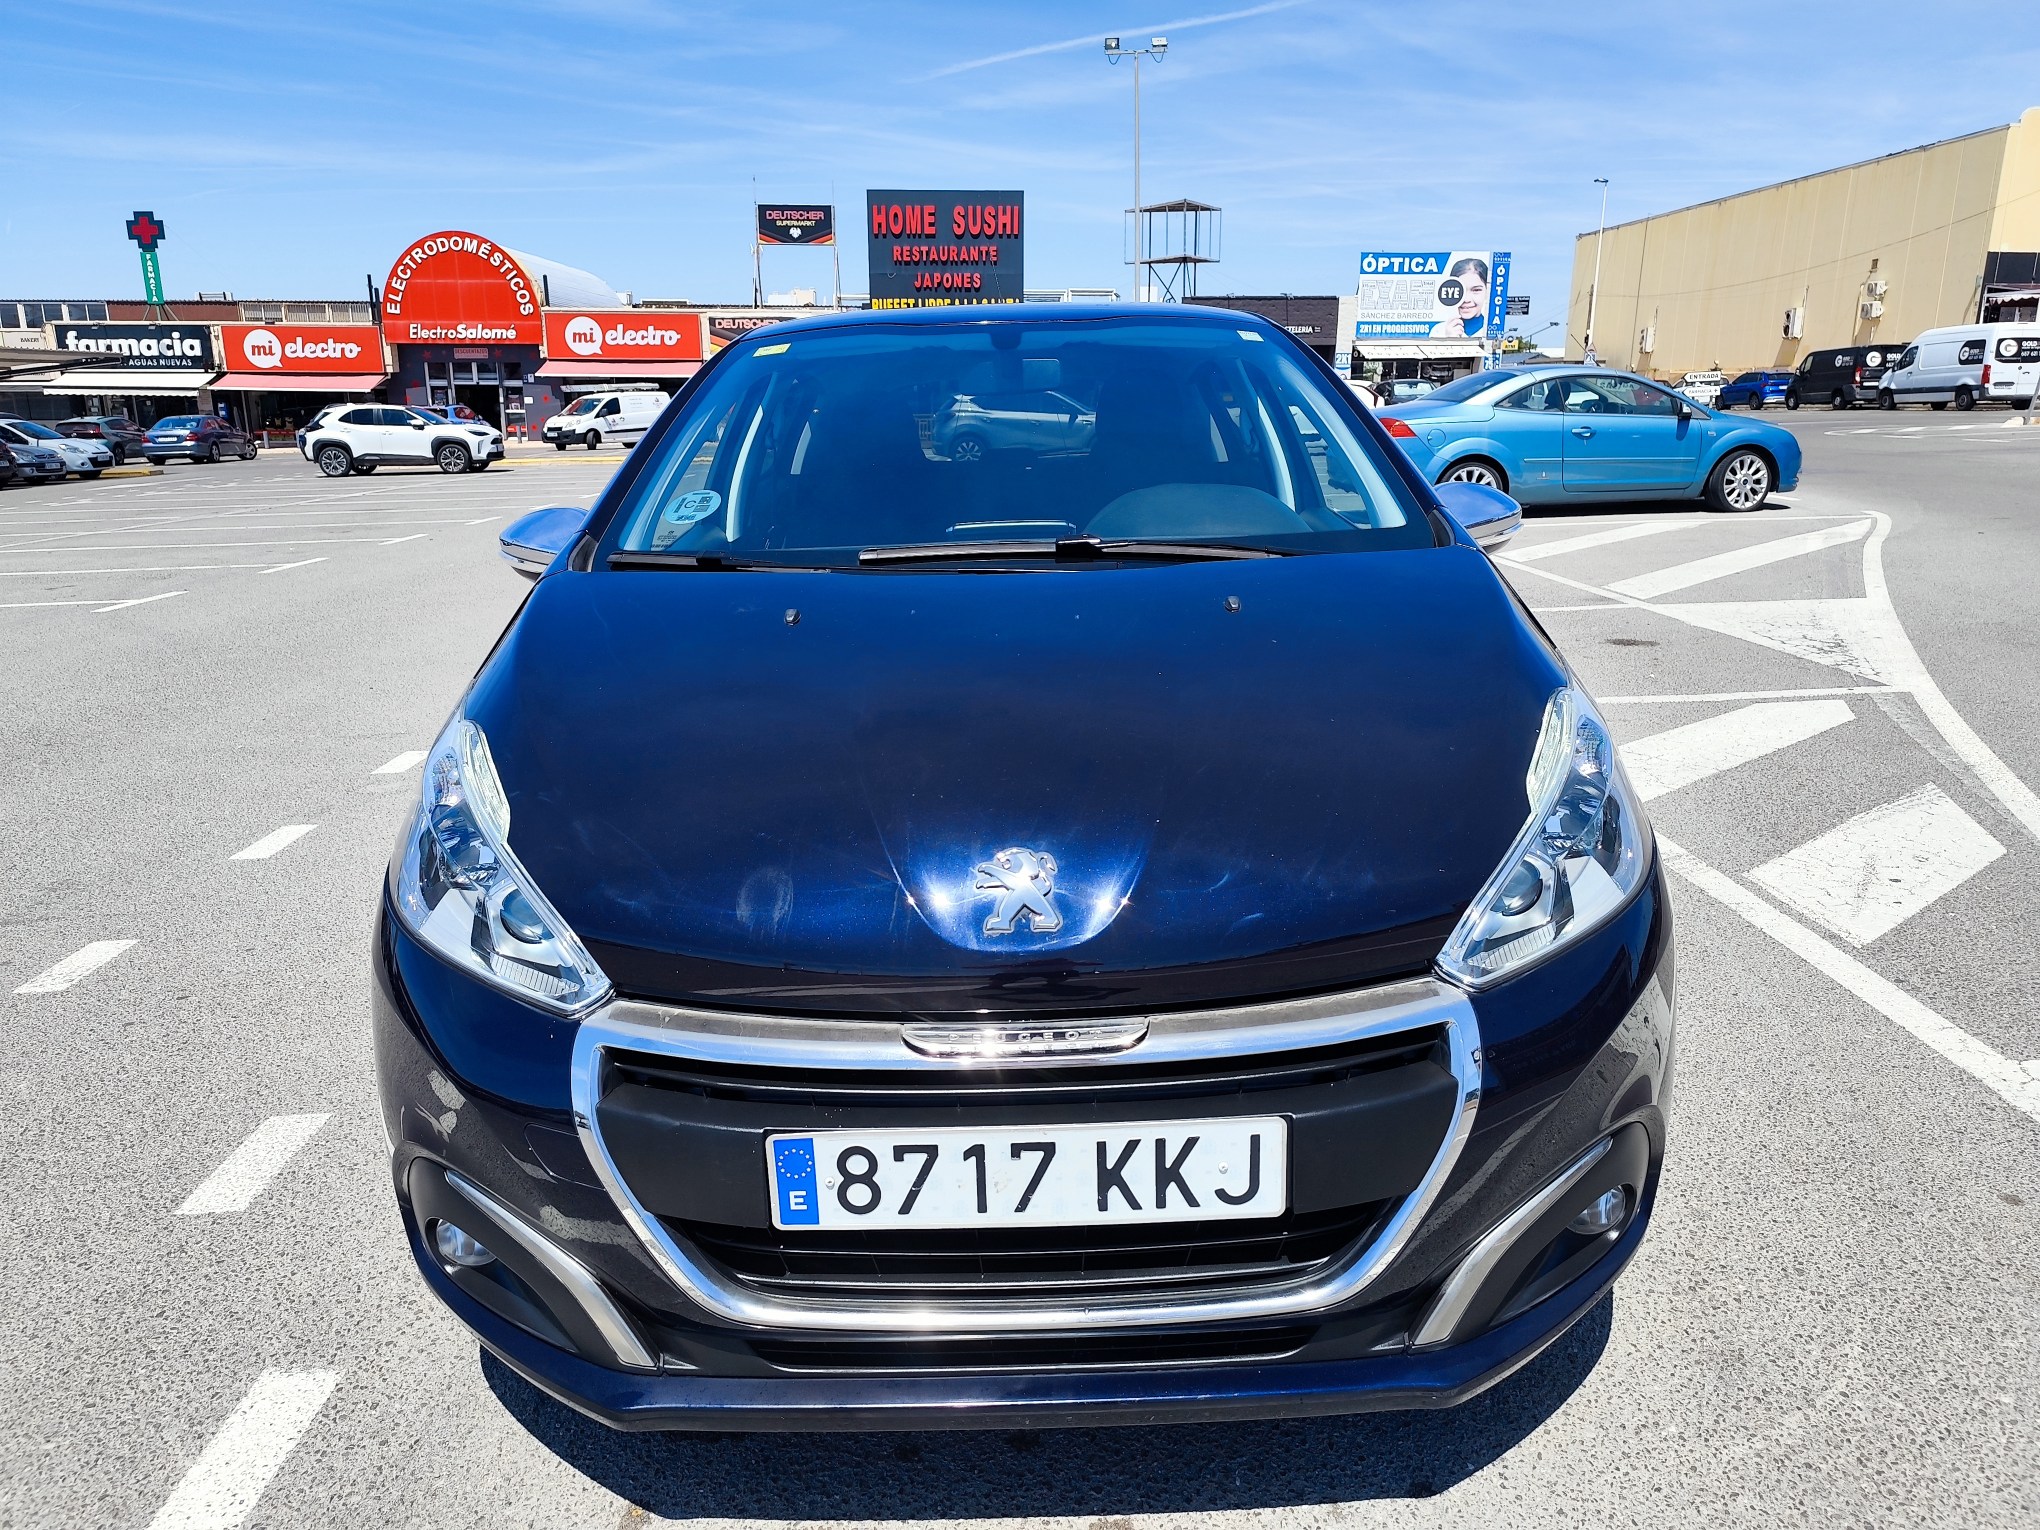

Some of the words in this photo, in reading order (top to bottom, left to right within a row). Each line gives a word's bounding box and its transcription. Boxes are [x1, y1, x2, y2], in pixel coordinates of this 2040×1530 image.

[766, 210, 825, 220] DEUTSCHER
[872, 204, 936, 236] HOME
[953, 204, 1020, 237] SUSHI
[893, 245, 998, 263] RESTAURANTE
[1362, 253, 1439, 273] ÓPTICA
[145, 253, 159, 302] FARMACIA
[386, 235, 534, 316] ELECTRODOMÉSTICOS
[914, 272, 981, 289] JAPONES
[1441, 286, 1460, 299] EYE
[1397, 311, 1434, 320] BARREDO
[409, 323, 517, 340] ElectroSalomé
[572, 327, 597, 344] mi
[604, 323, 681, 346] electro
[1359, 325, 1371, 334] 2X1
[1373, 325, 1382, 334] EN
[1383, 324, 1430, 334] PROGRESIVOS
[65, 331, 202, 356] farmacia
[251, 340, 276, 356] mi
[284, 337, 362, 359] electro
[129, 358, 157, 366] AGUAS
[160, 358, 193, 366] NUEVAS
[1336, 354, 1351, 364] 2X1
[789, 1190, 808, 1211] E
[836, 1145, 1057, 1216] 8717
[1097, 1134, 1261, 1213] KKJ
